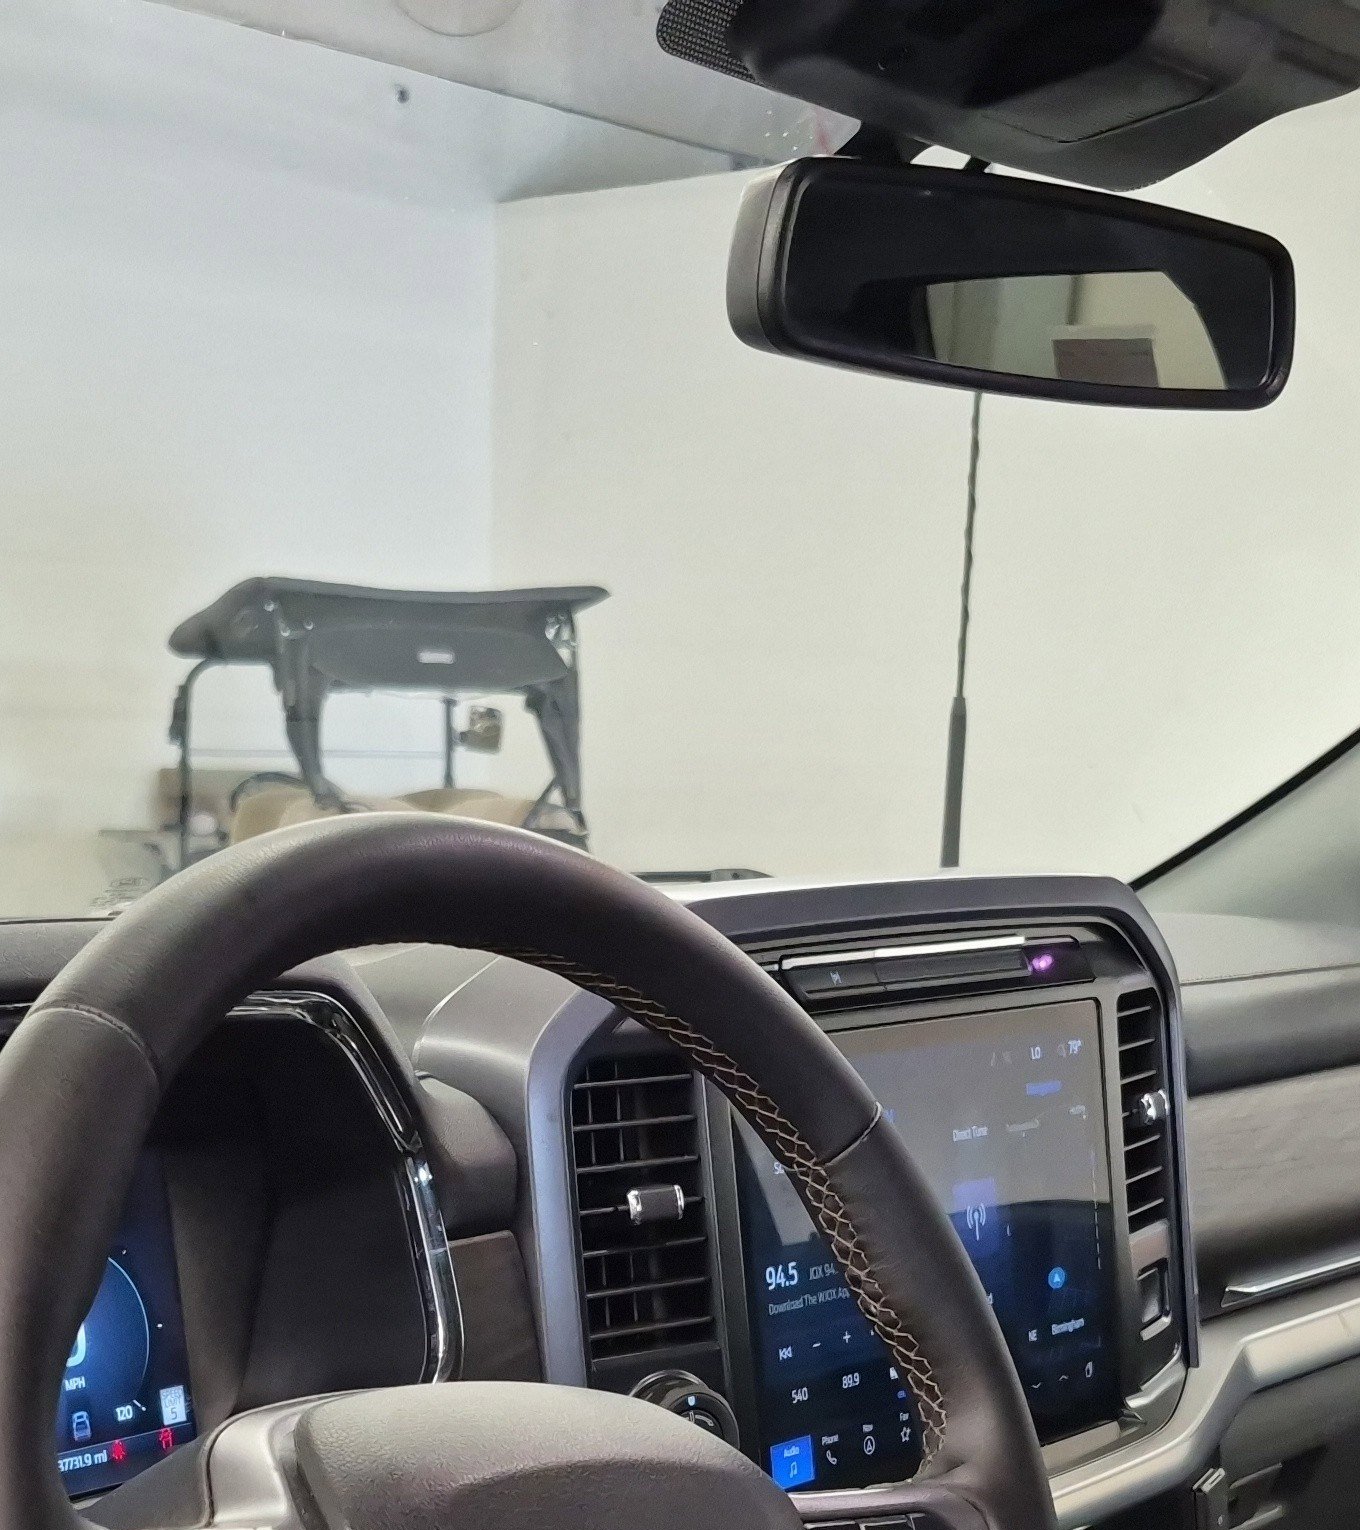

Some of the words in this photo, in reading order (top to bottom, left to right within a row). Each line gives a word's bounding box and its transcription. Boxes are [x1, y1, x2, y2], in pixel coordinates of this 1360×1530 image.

[765, 1261, 798, 1290] 94.5
[64, 1376, 86, 1391] MPH
[842, 1372, 860, 1389] 89.9
[791, 1387, 809, 1404] 540
[115, 1404, 133, 1421] 120
